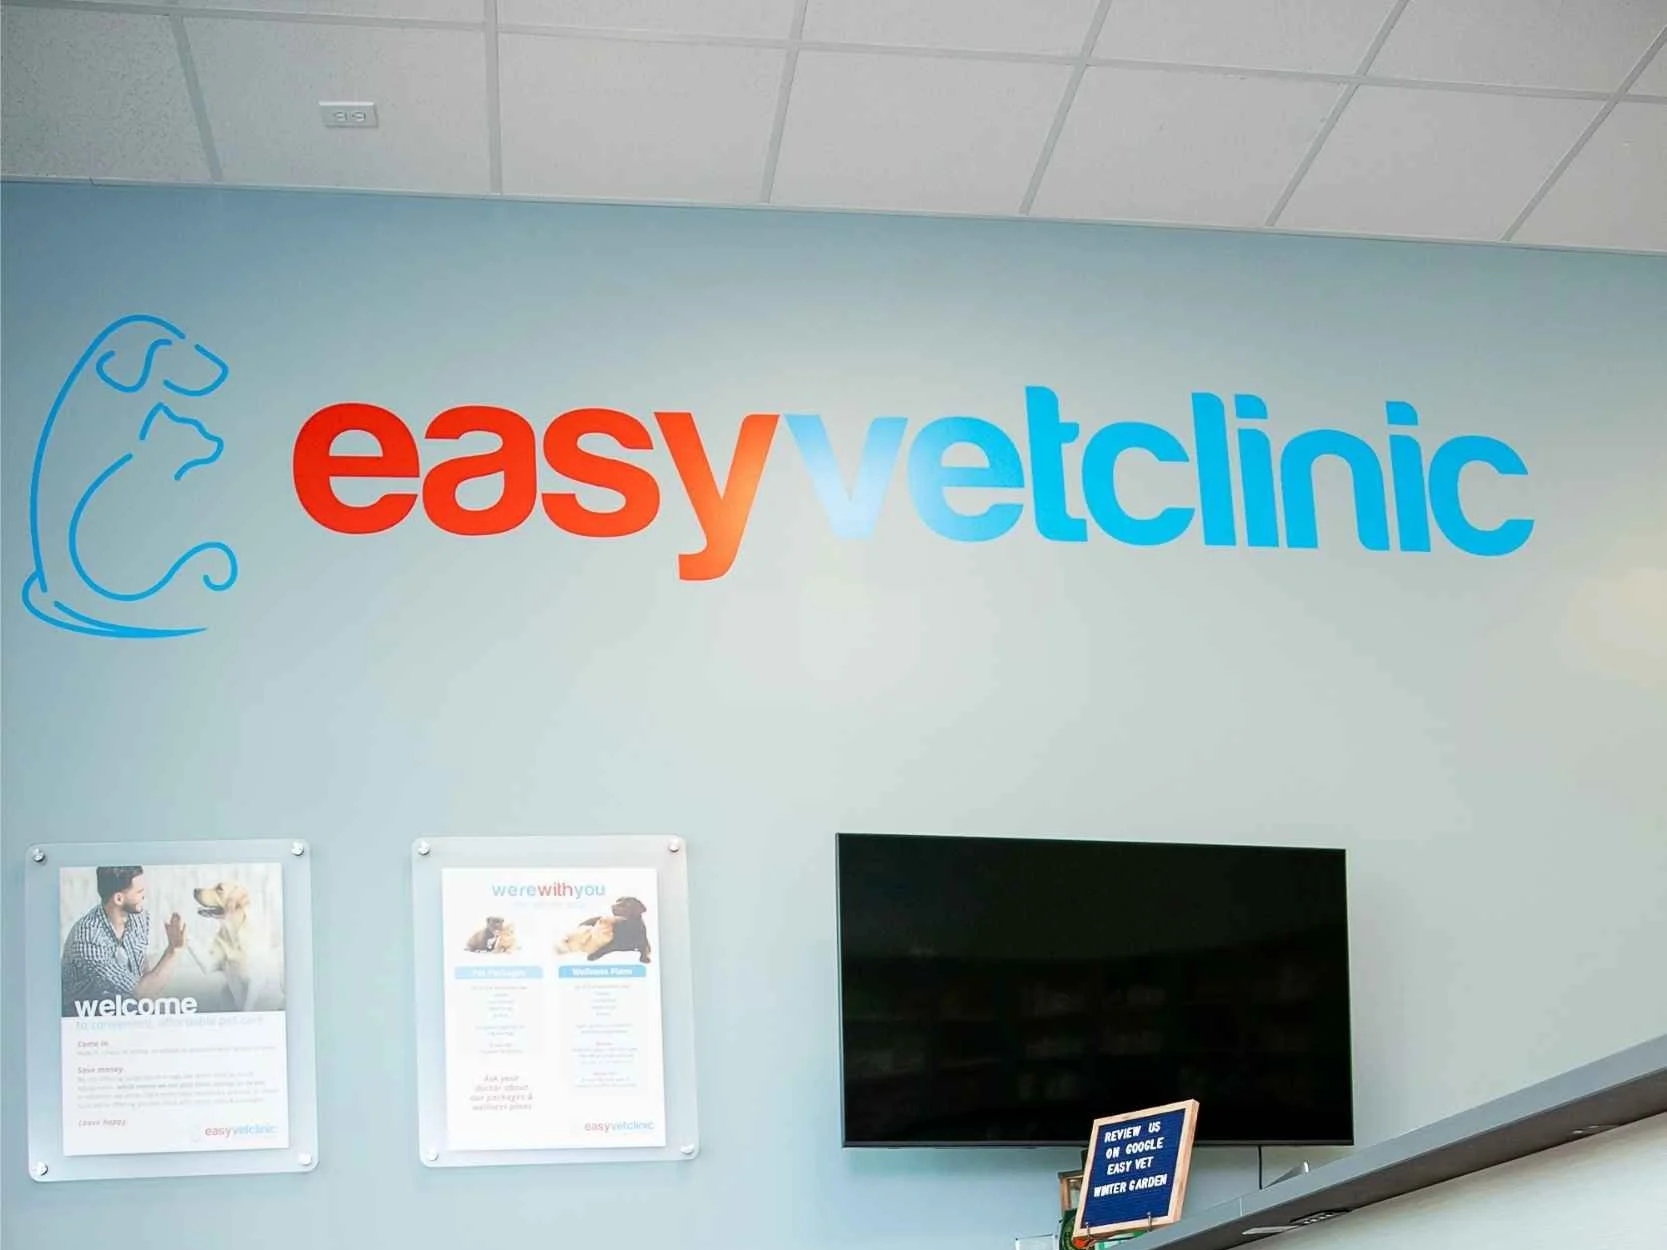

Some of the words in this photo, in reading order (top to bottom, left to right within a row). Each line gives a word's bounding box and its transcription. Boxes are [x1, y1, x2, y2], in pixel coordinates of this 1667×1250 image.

[292, 385, 1534, 581] easyvetclinic
[492, 880, 606, 899] werewithyou
[75, 994, 198, 1017] welcome
[1104, 1125, 1141, 1143] REVIEW
[1148, 1121, 1161, 1133] US
[1105, 1148, 1120, 1159] ON
[1125, 1137, 1165, 1154] GOOGLE
[1107, 1159, 1132, 1175] EASY
[1134, 1156, 1154, 1170] VET
[1093, 1181, 1127, 1197] WINTER
[1128, 1174, 1168, 1191] GARDEN
